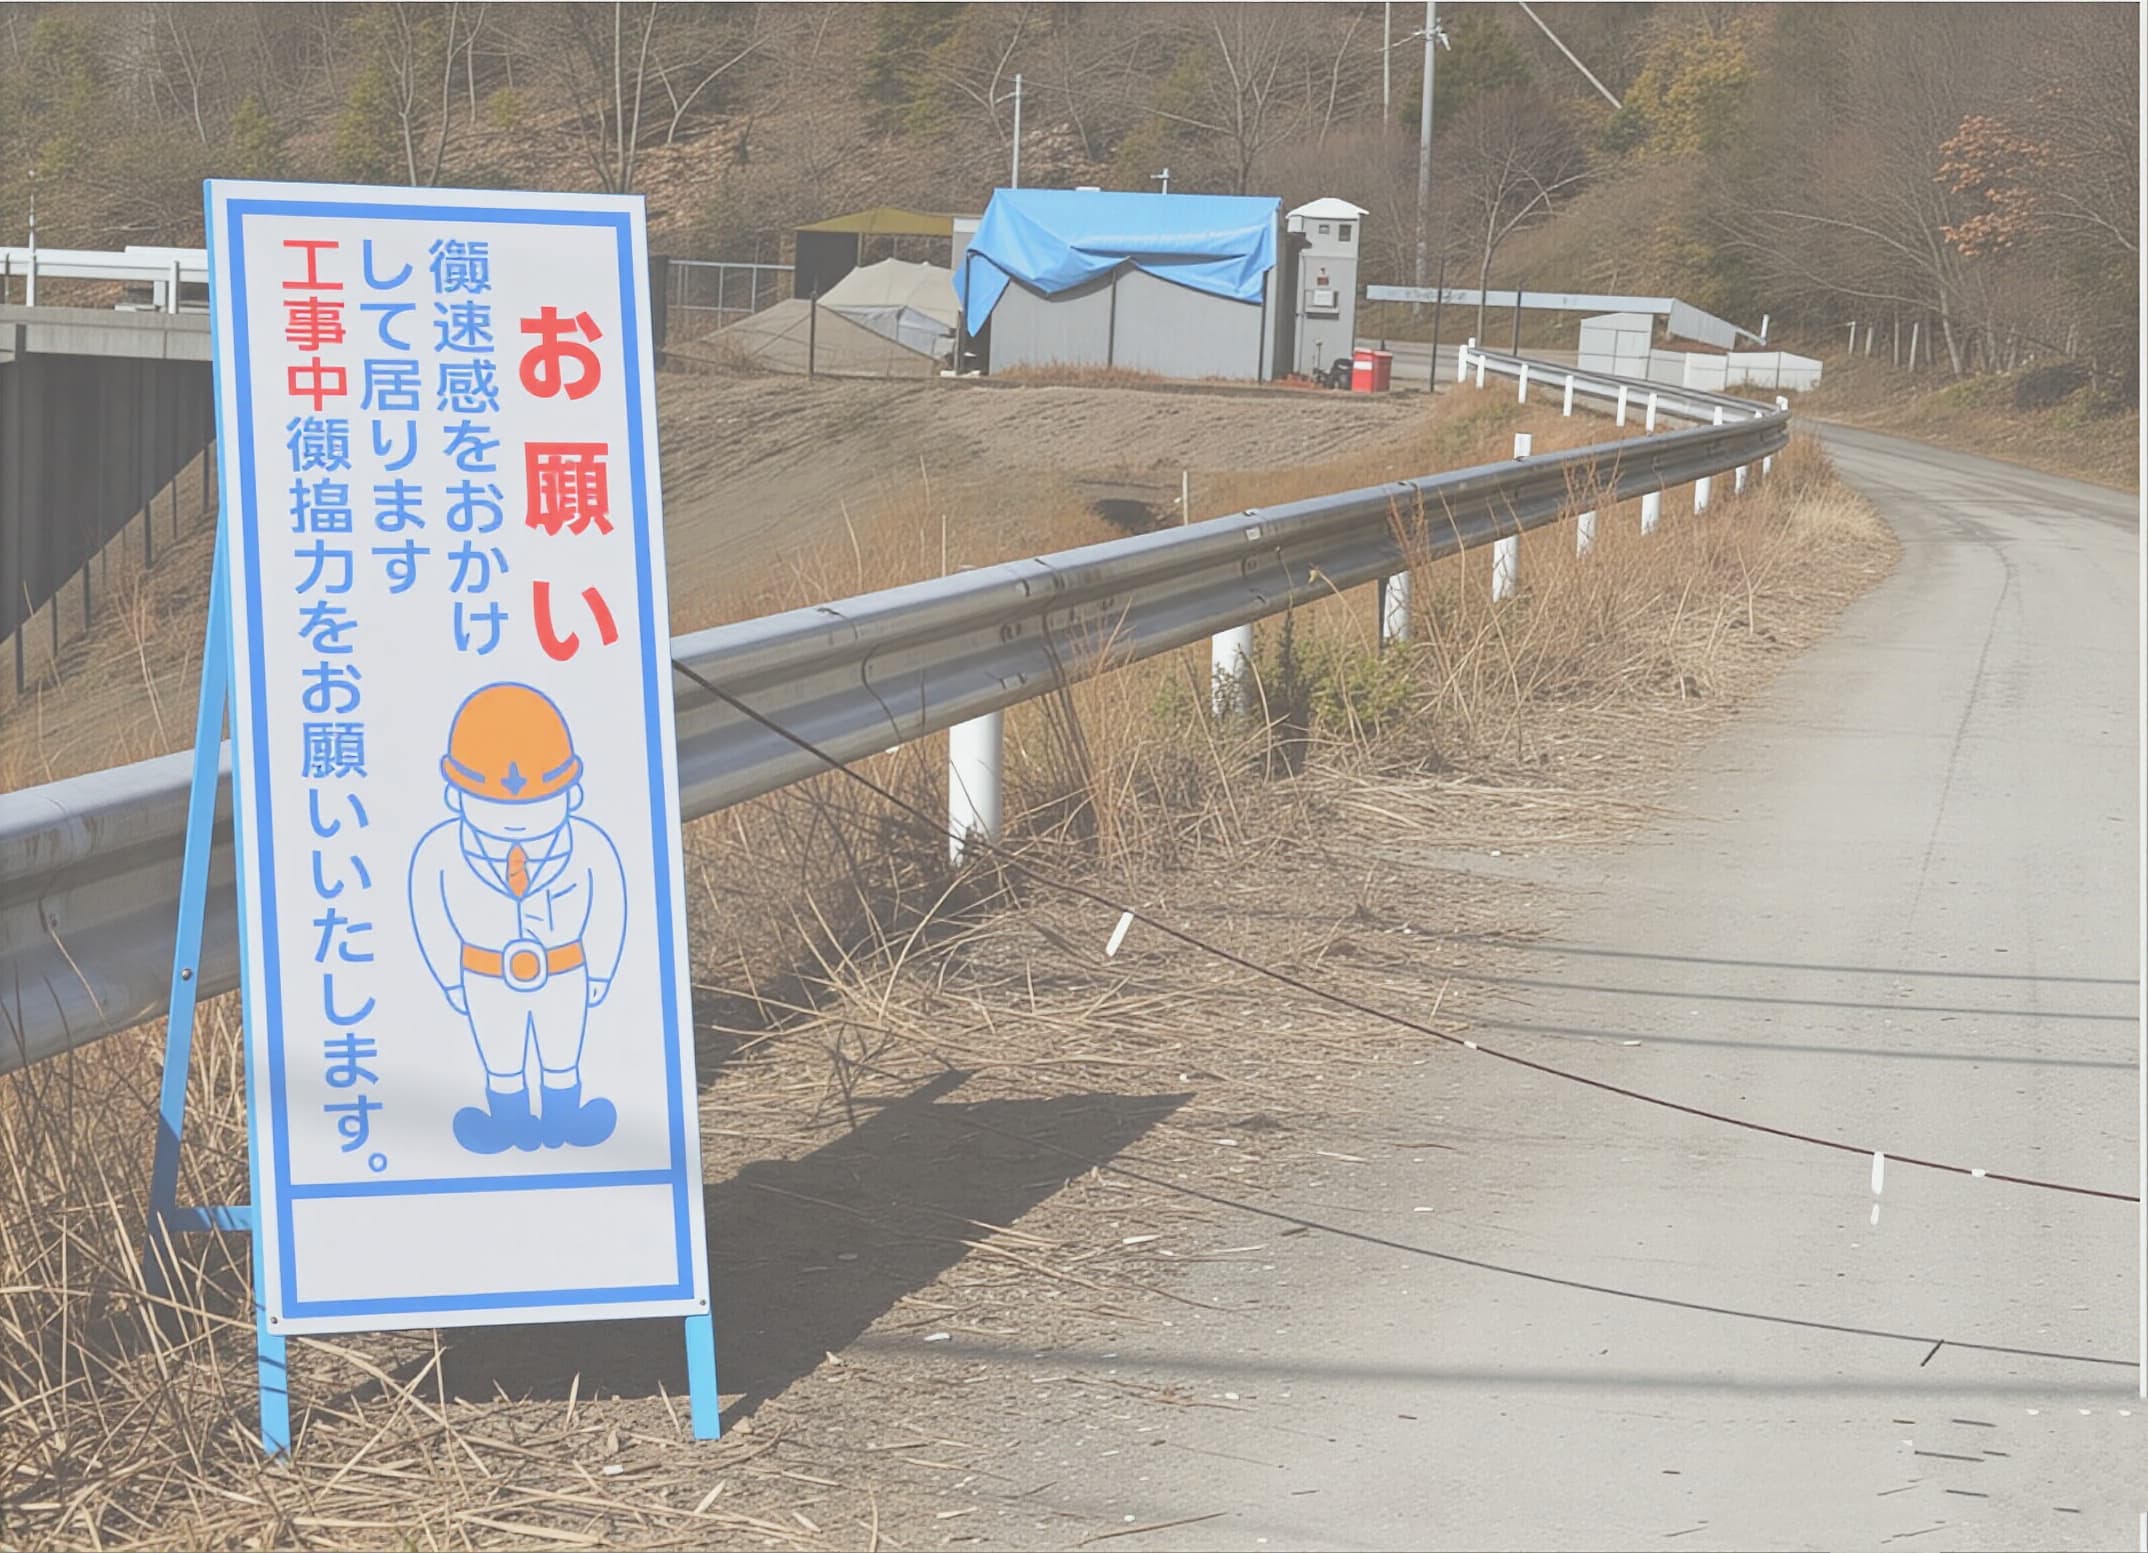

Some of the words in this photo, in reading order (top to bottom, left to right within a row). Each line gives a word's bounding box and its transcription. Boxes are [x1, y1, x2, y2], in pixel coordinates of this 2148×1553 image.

[360, 239, 431, 595] して居ります
